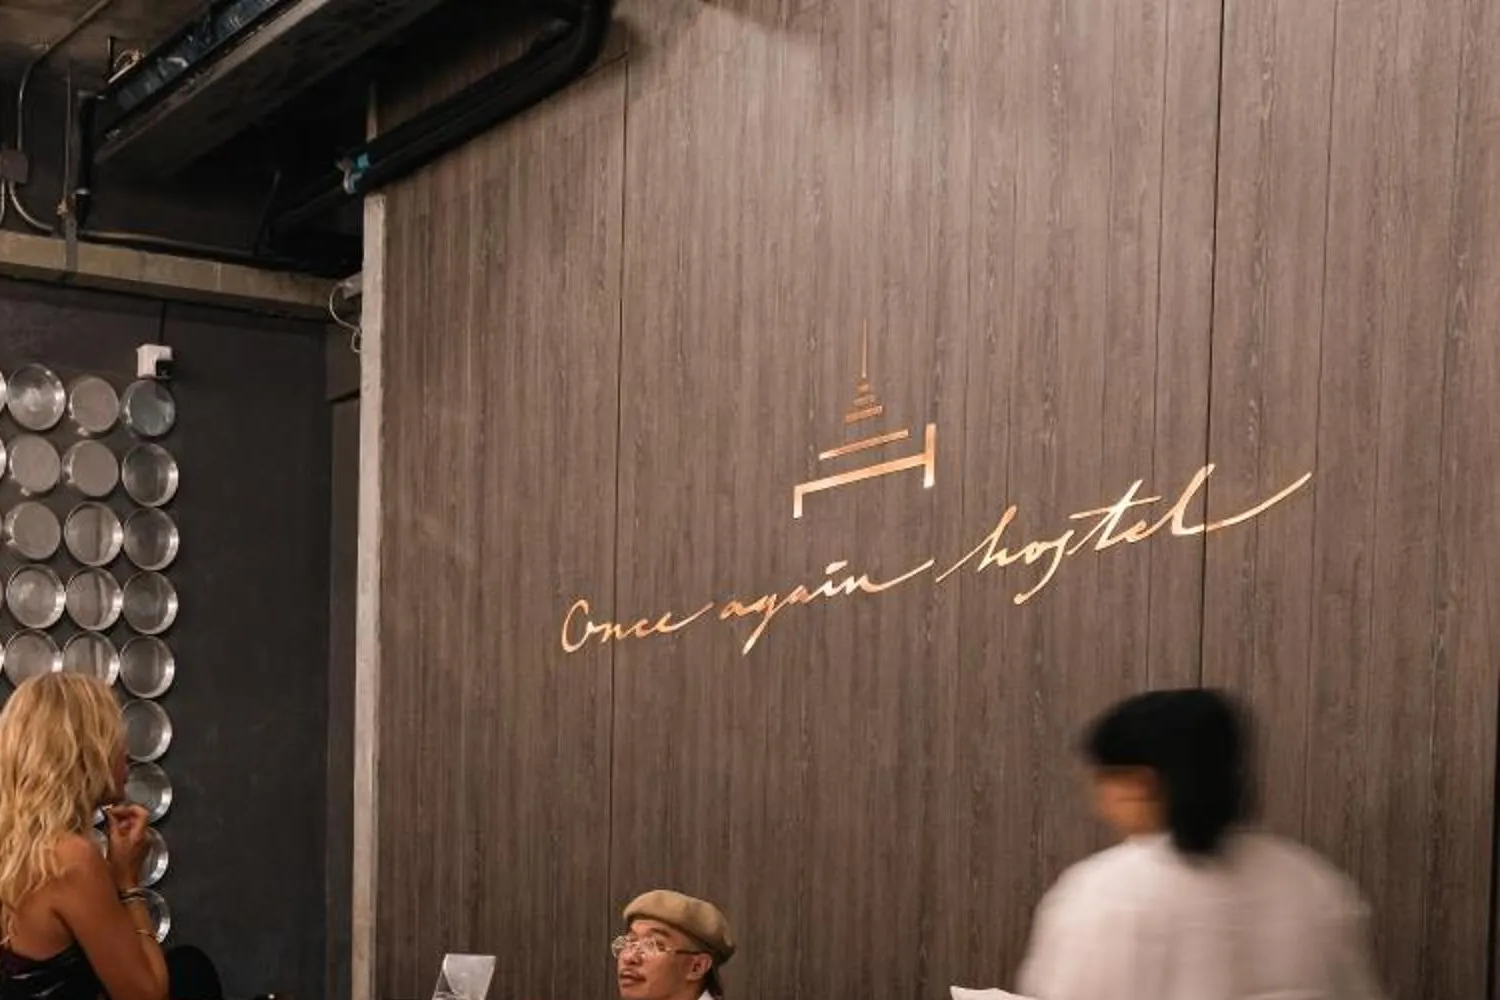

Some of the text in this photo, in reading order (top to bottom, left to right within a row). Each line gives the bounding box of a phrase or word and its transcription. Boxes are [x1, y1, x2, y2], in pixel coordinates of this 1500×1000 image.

[560, 463, 1313, 655] Once again hostel
